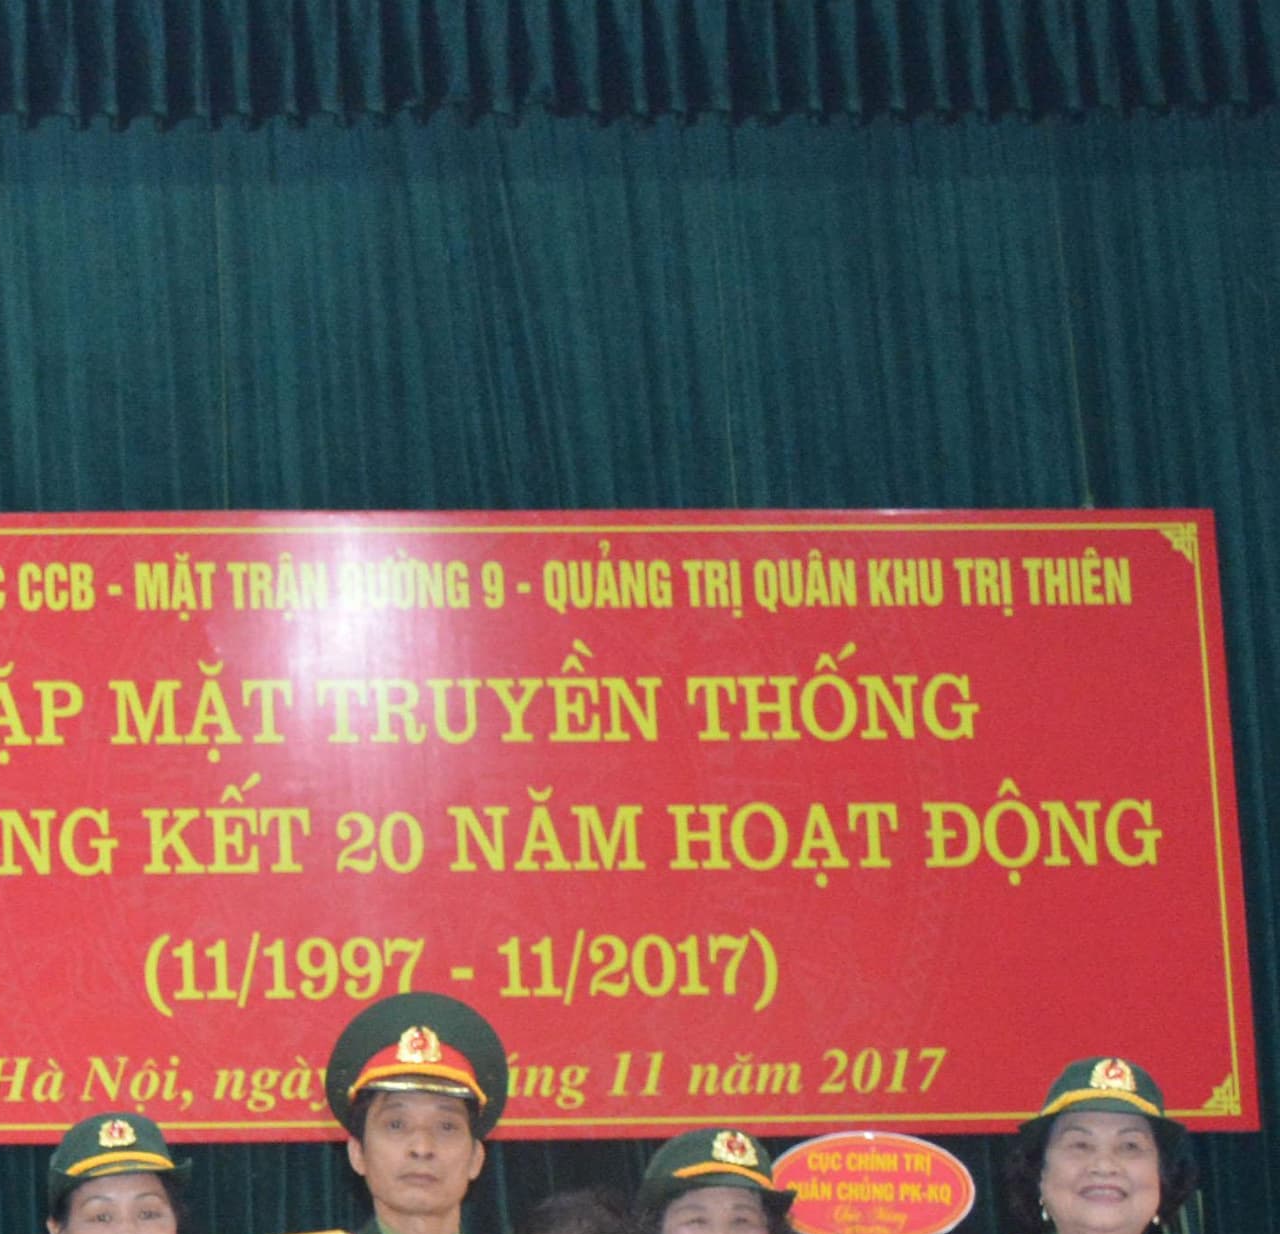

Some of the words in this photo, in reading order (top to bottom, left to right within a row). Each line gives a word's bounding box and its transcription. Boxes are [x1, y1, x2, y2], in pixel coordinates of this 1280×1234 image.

[18, 562, 95, 611] CCB
[135, 553, 217, 621] MẶT
[226, 552, 328, 621] TRẬN
[482, 562, 505, 608] 9
[544, 540, 672, 613] QUẢNG
[683, 560, 742, 618] TRỊ
[754, 549, 857, 612] QUÂN
[868, 559, 943, 606] KHU
[954, 559, 1012, 616] TRỊ
[1023, 548, 1131, 604] THIÊN
[108, 660, 293, 763] MẶT
[317, 639, 662, 744] TRUYỀN
[687, 643, 979, 741] THỐNG
[143, 774, 311, 874] KẾT
[337, 812, 424, 873] 20
[448, 788, 646, 871] NĂM
[668, 802, 898, 887] HOẠT
[923, 779, 1162, 885] ĐỘNG
[145, 932, 425, 1017] (11/1997
[499, 929, 778, 1011] 11/2017)
[82, 1056, 194, 1113] Nội,
[611, 1052, 663, 1096] 11
[689, 1056, 800, 1095] năm
[821, 1048, 946, 1093] 2017
[807, 1151, 841, 1174] CỤC
[846, 1147, 899, 1173] CHÍNH
[904, 1152, 933, 1176] TRỊ
[900, 1183, 952, 1205] PK-KQ
